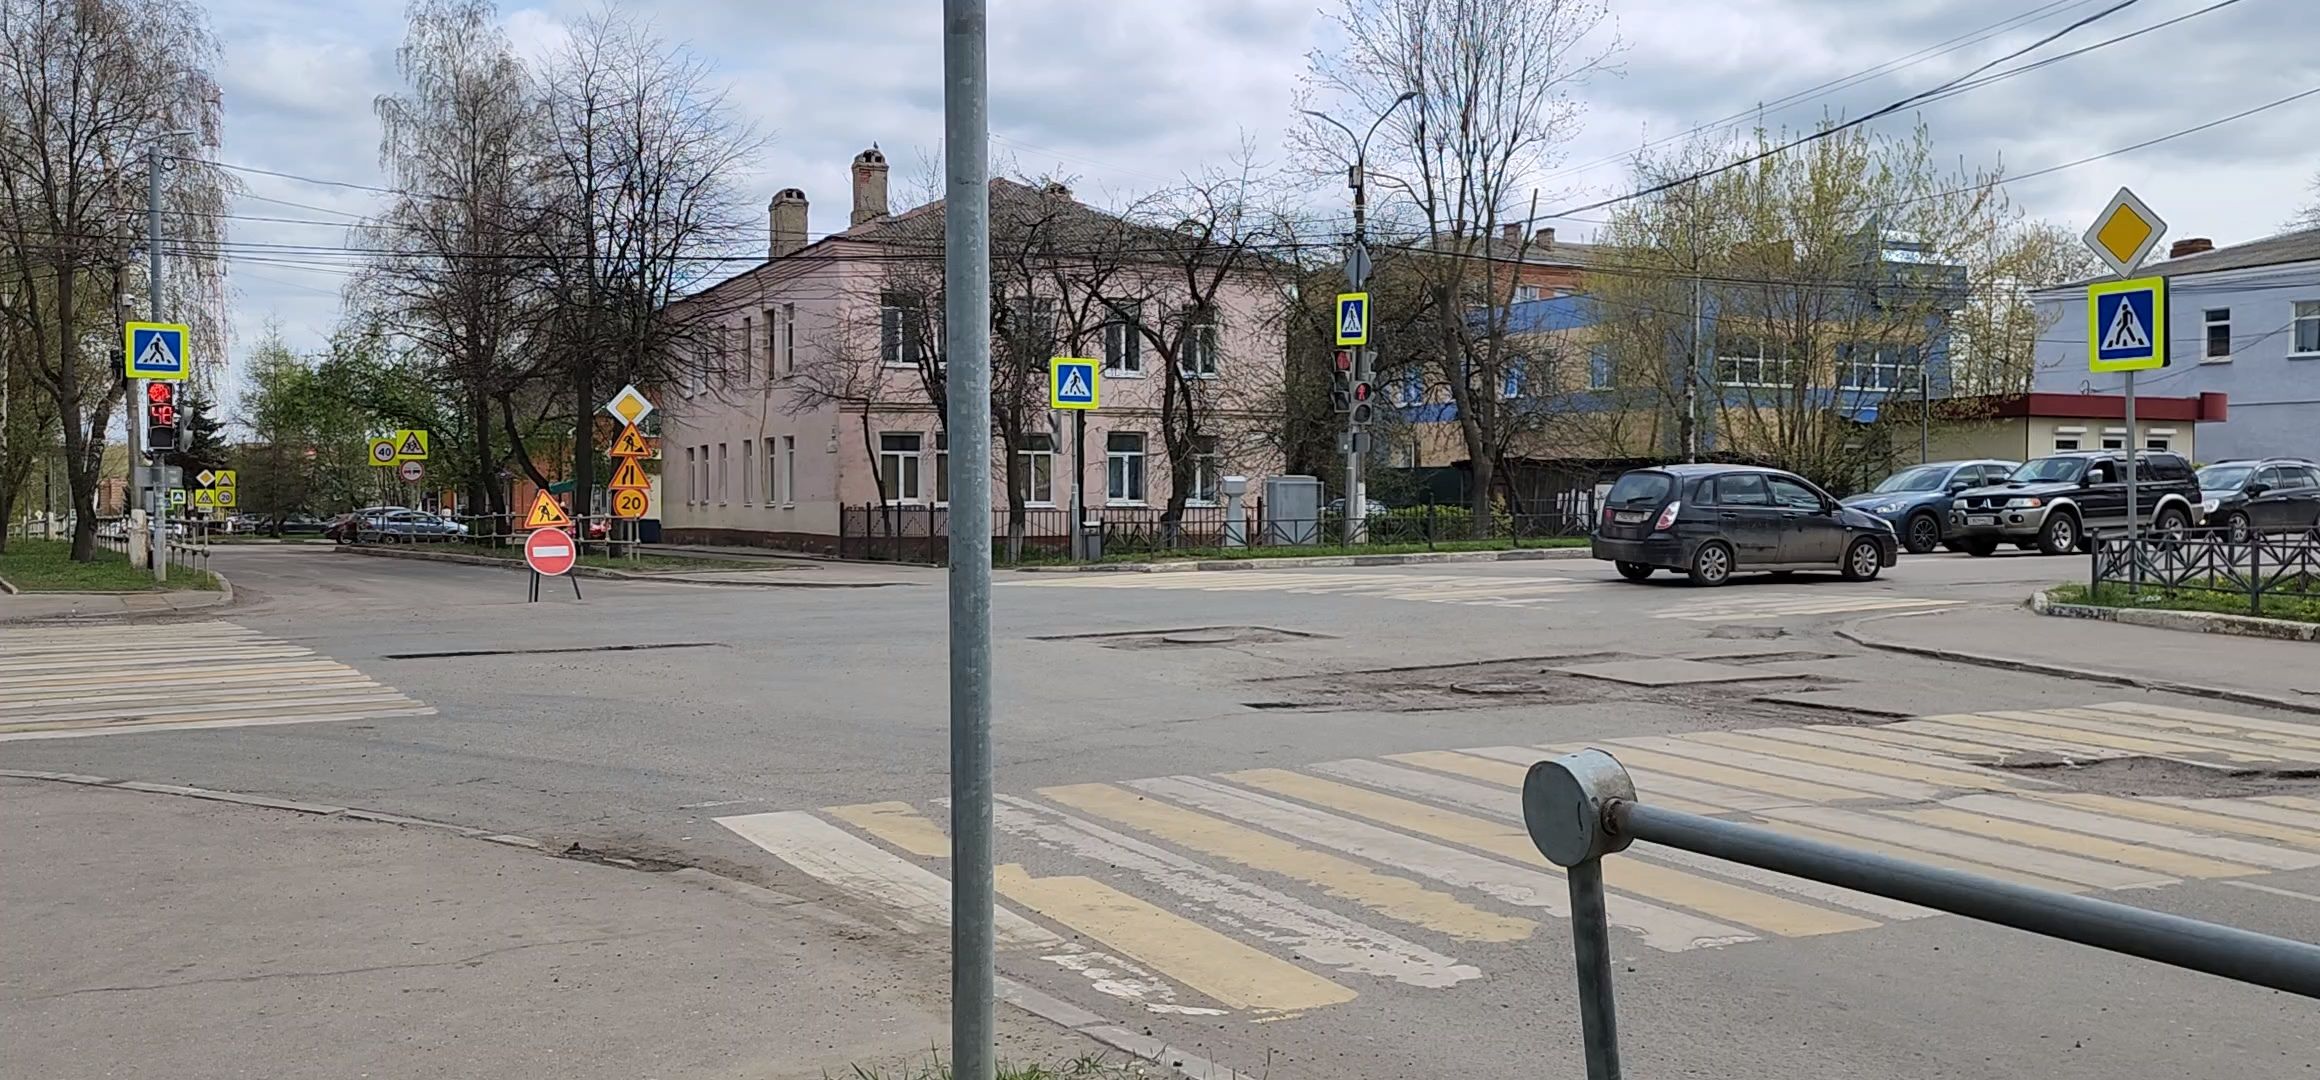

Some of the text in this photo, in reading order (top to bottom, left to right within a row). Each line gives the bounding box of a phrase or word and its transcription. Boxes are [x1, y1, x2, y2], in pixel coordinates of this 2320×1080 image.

[151, 406, 172, 425] 48
[378, 447, 391, 457] 40
[621, 496, 641, 510] 20
